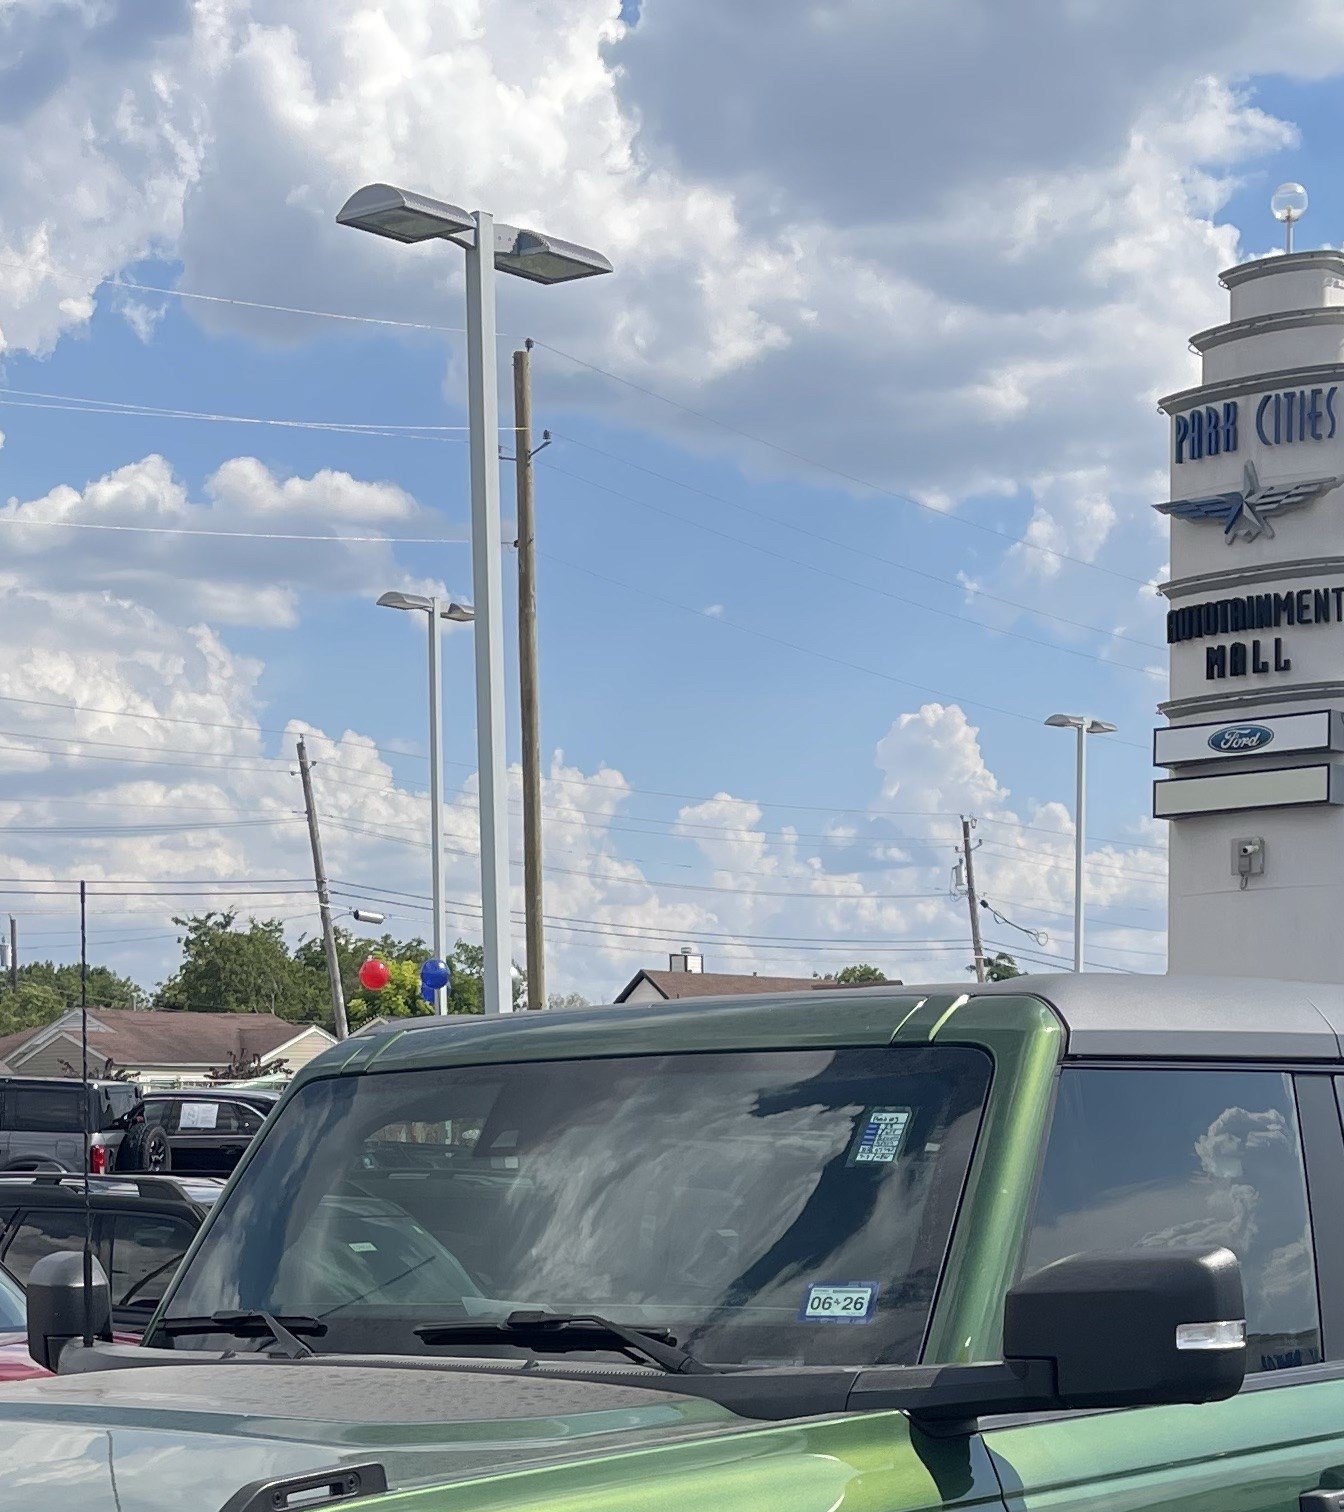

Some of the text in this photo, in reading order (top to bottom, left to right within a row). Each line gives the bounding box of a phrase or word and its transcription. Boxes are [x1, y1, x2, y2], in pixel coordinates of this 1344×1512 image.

[1174, 386, 1339, 464] PARK CITIES
[1206, 637, 1291, 680] MALL
[1220, 725, 1261, 750] Ford
